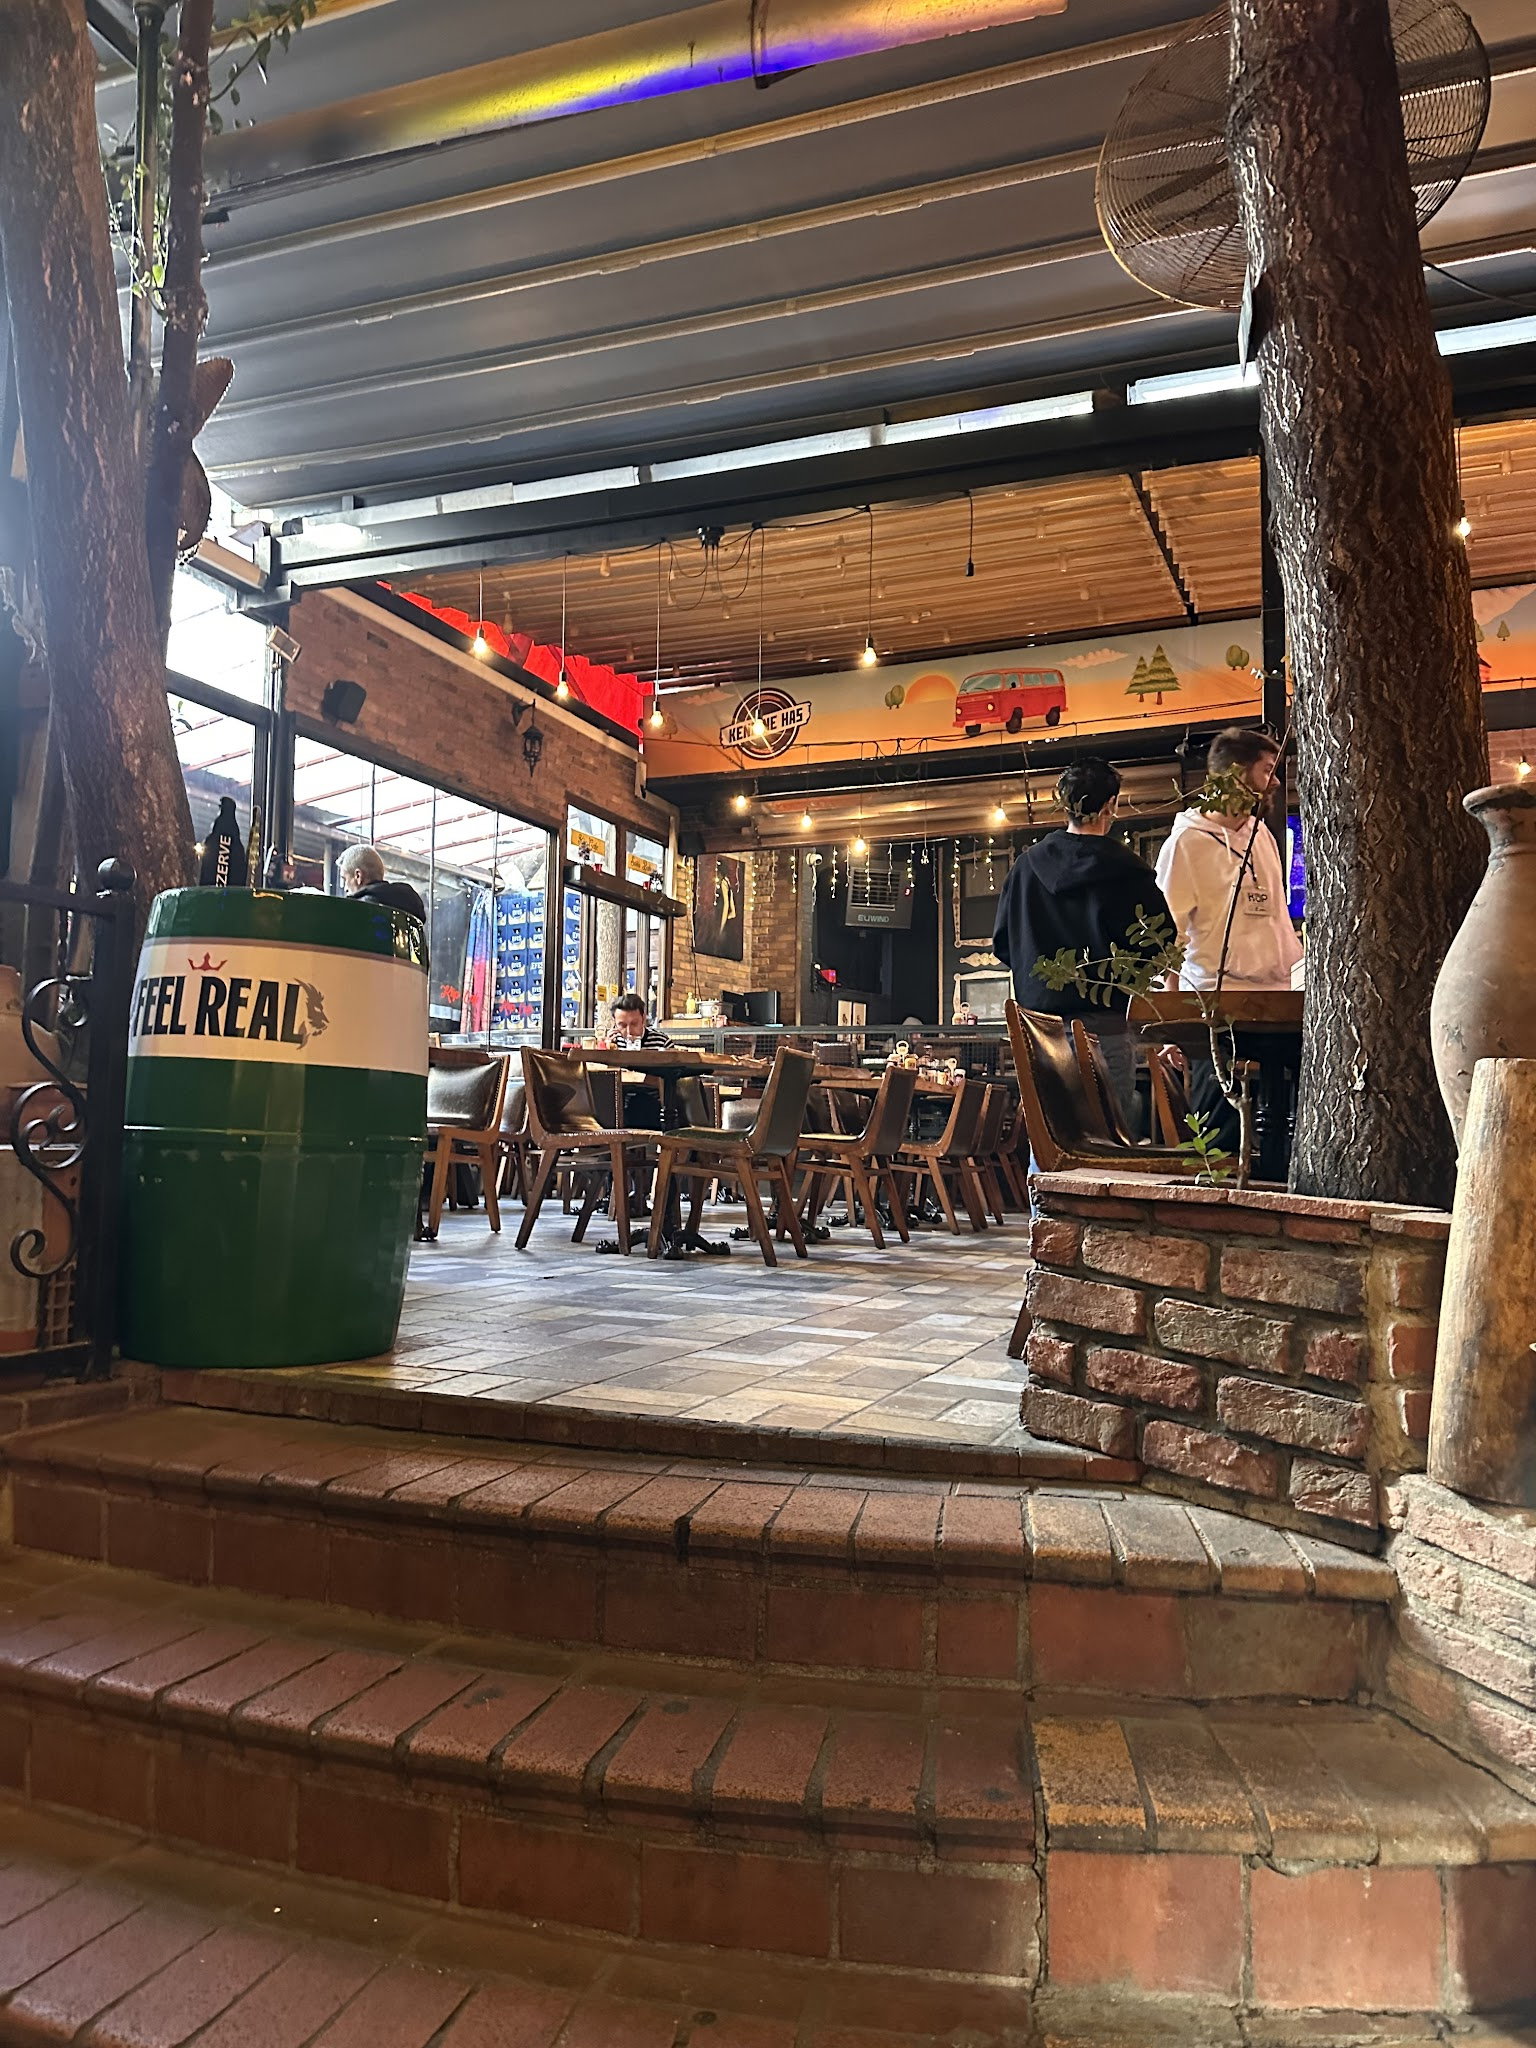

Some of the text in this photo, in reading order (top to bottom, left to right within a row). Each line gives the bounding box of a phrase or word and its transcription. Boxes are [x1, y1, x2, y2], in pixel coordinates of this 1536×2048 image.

[729, 707, 804, 744] KENNE HAS
[132, 975, 304, 1045] FEEL REAL
